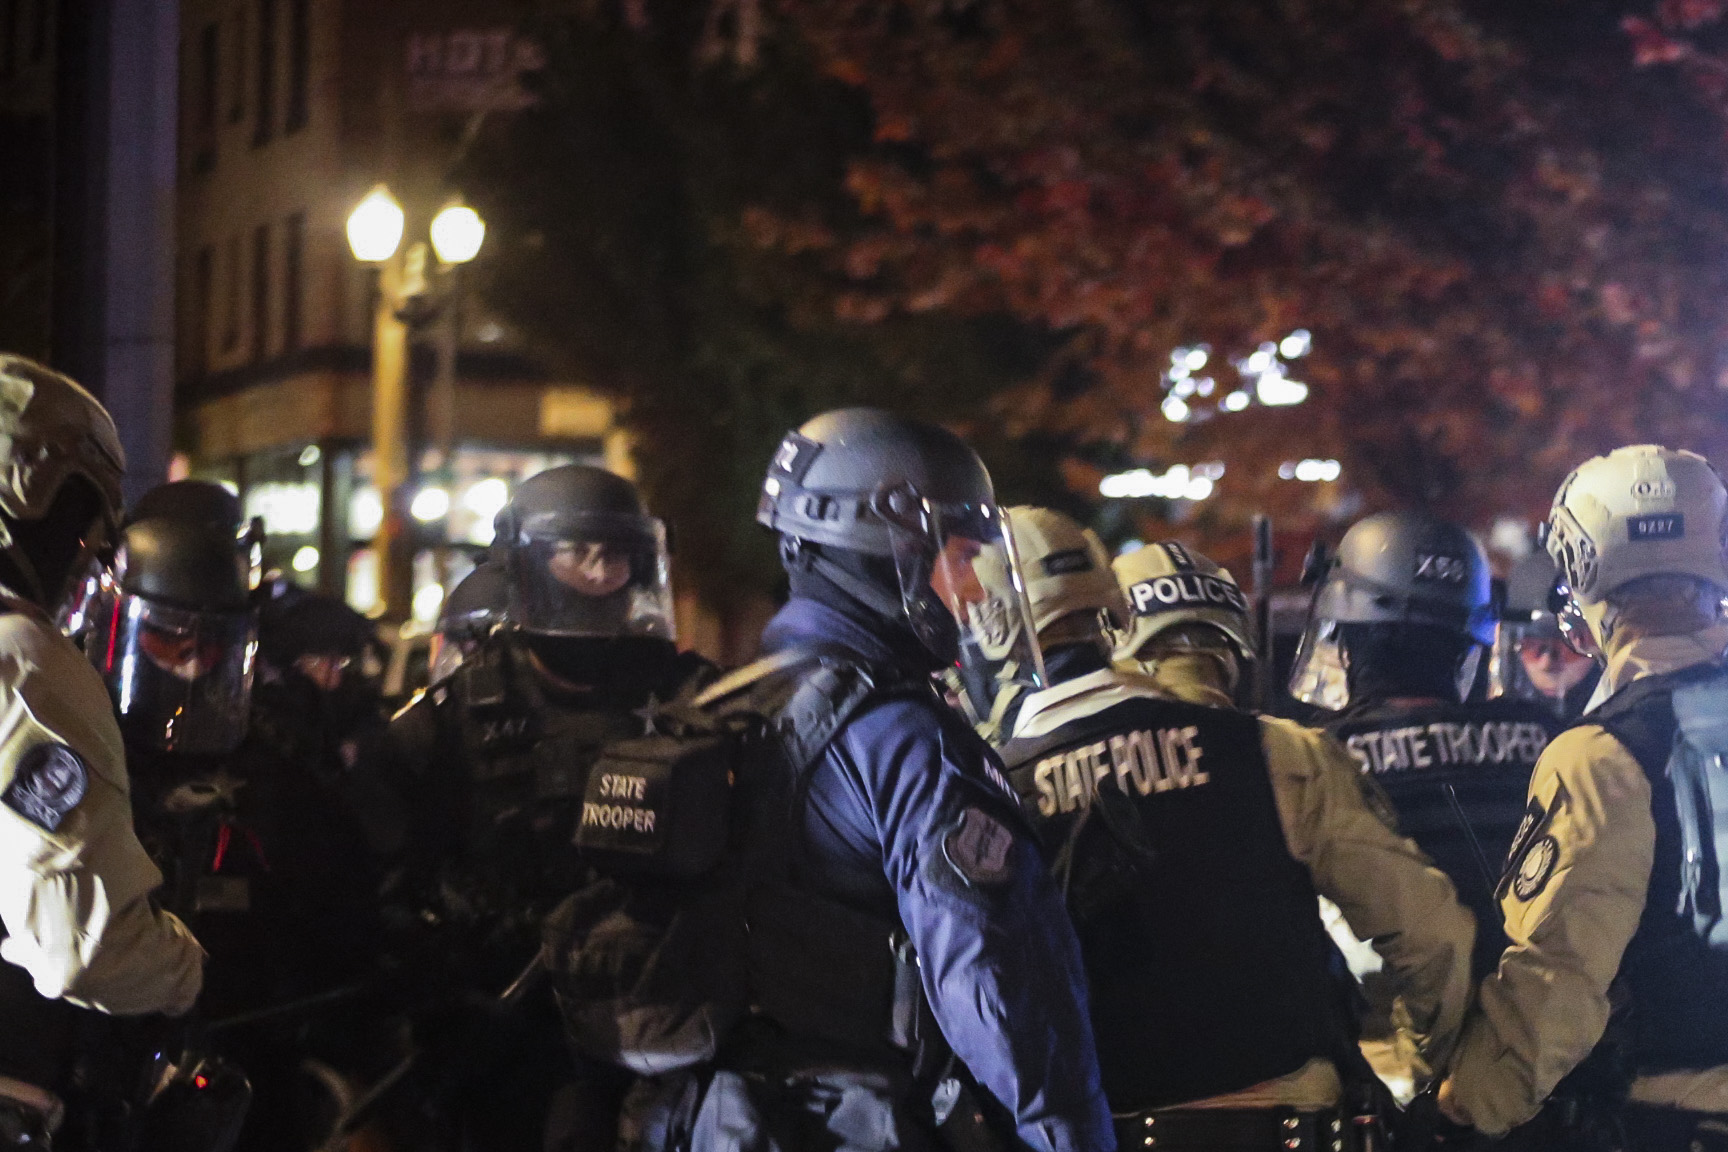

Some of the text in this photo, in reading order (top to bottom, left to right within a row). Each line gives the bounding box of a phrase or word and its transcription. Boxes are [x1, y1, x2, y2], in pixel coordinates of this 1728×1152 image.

[1132, 577, 1249, 613] POLICE
[1347, 723, 1433, 775] STATE
[600, 773, 648, 801] STATE
[1034, 740, 1111, 818] STATE
[1109, 725, 1211, 797] POLICE
[582, 802, 657, 833] TROOPER
